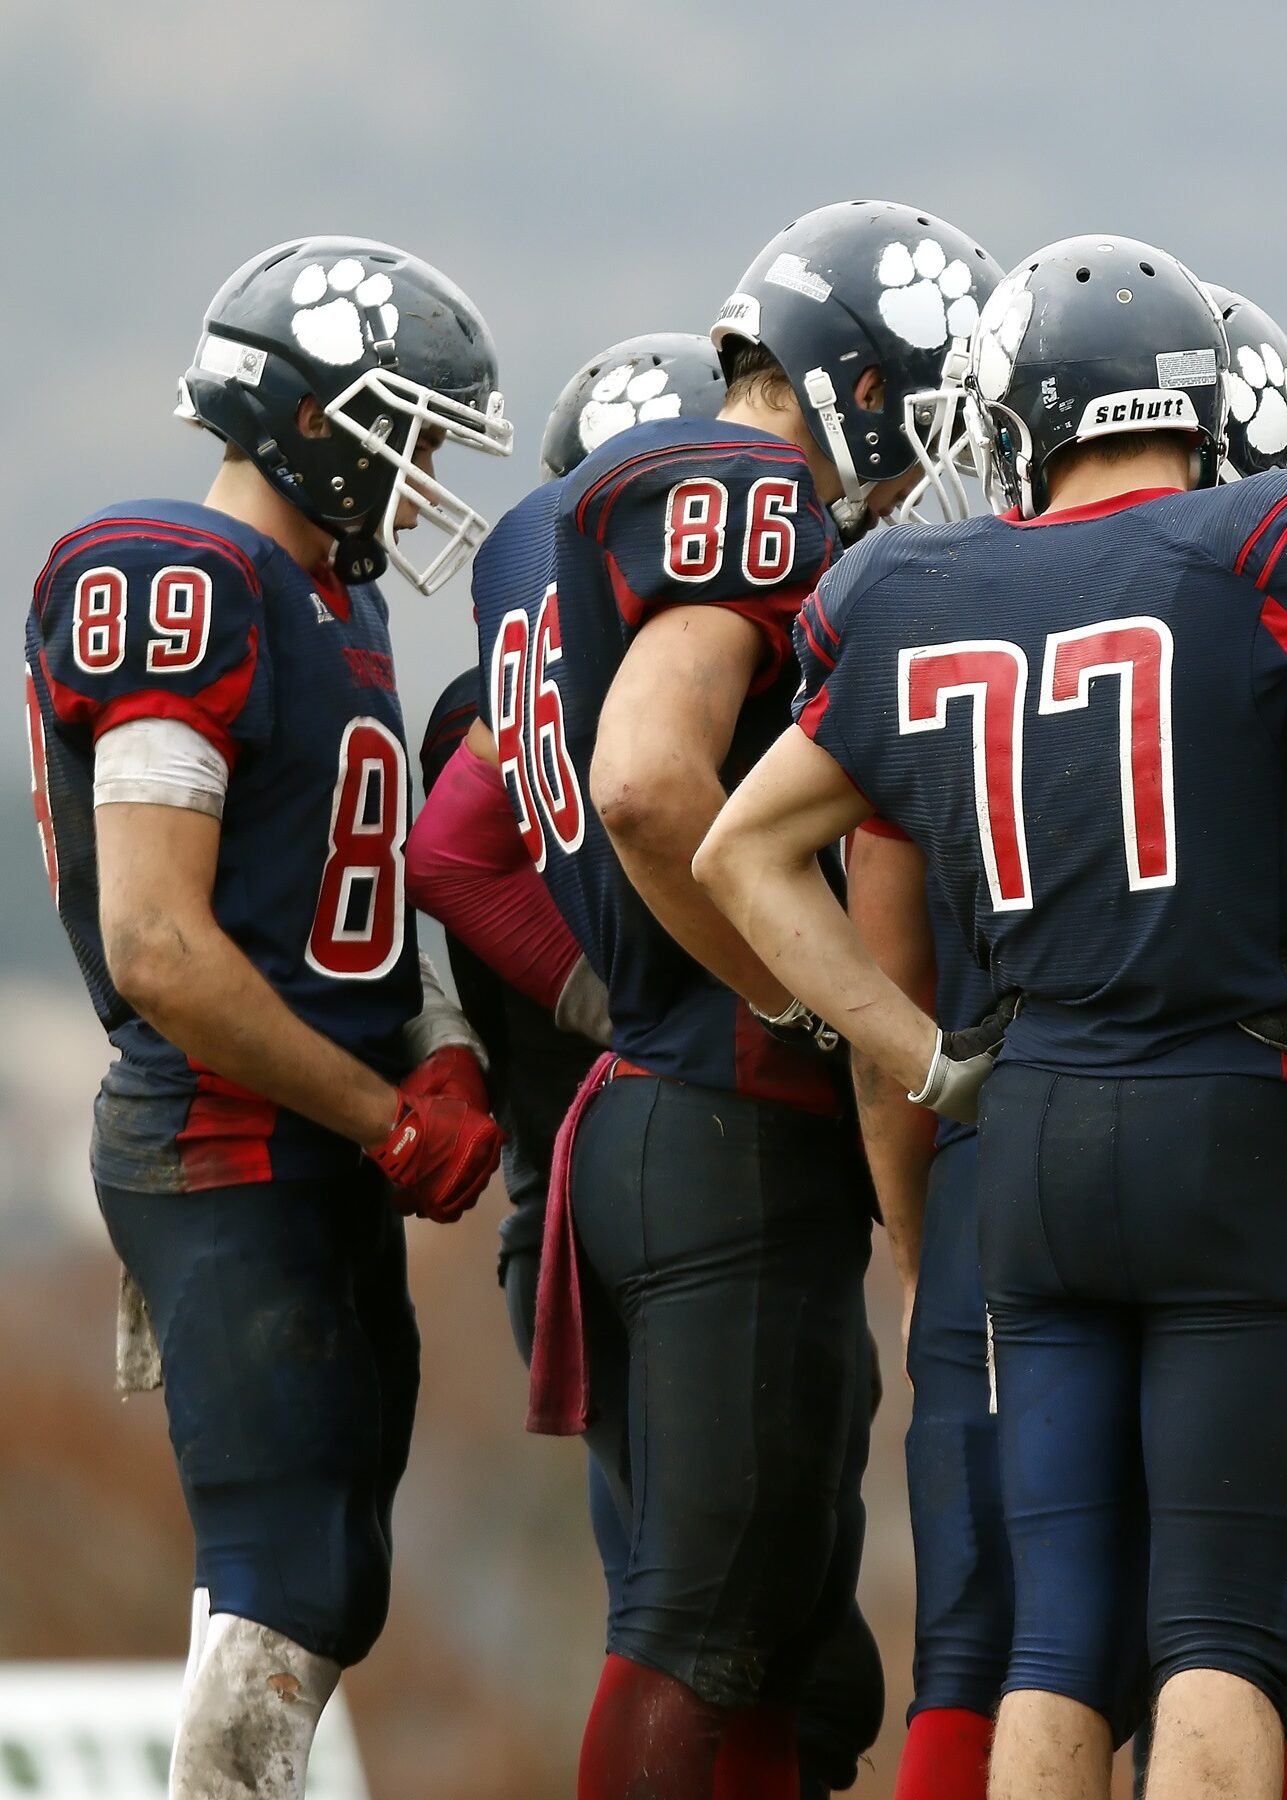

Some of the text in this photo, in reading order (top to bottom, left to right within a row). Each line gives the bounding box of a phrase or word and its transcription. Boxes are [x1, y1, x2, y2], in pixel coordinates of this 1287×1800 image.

[1095, 398, 1184, 424] schutt
[73, 566, 213, 674] 89
[663, 477, 799, 585] 86
[490, 580, 586, 873] 86
[898, 616, 1176, 913] 77
[304, 715, 409, 980] 8
